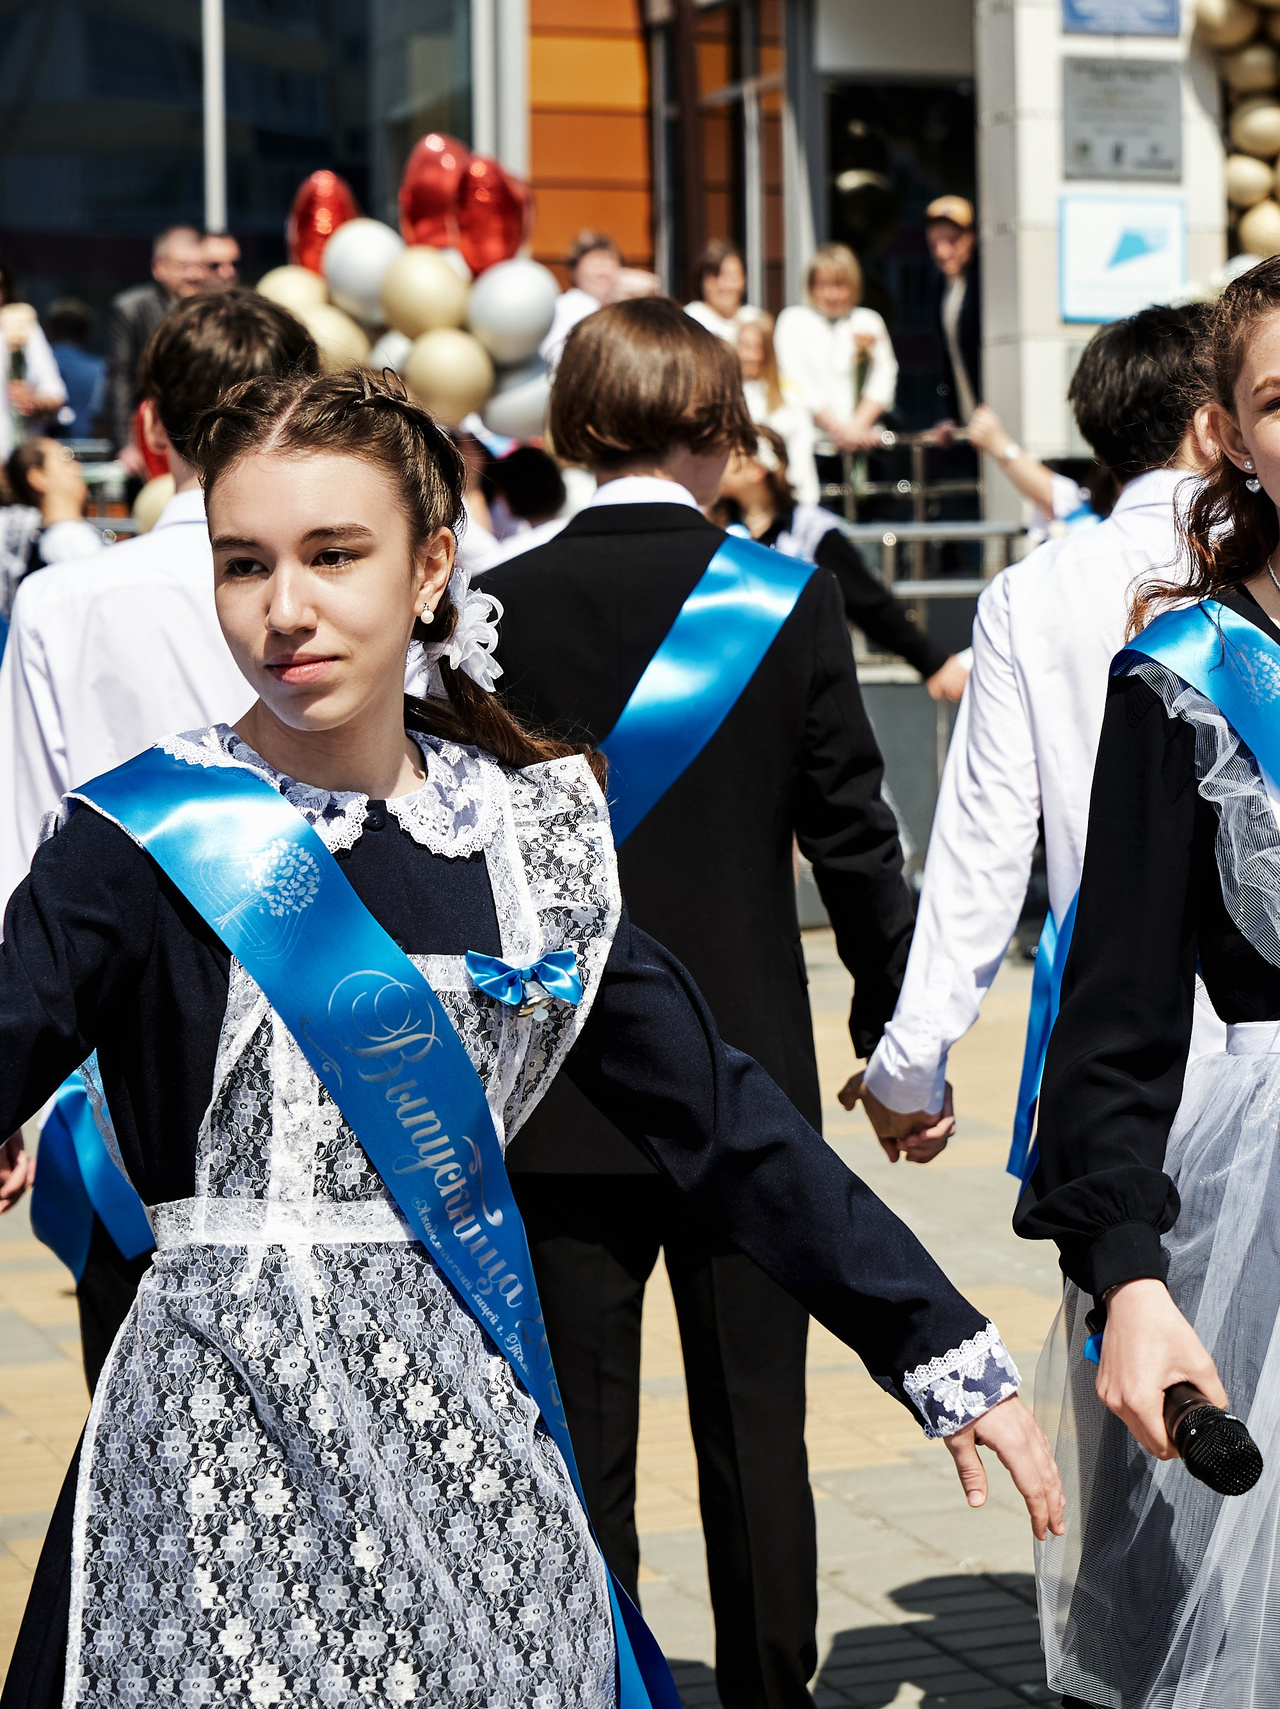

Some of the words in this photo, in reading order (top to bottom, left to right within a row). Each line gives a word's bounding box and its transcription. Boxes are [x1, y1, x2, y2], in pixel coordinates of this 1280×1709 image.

[327, 969, 523, 1309] Выпускница
[471, 1292, 500, 1326] лицей
[503, 1332, 534, 1381] Том
